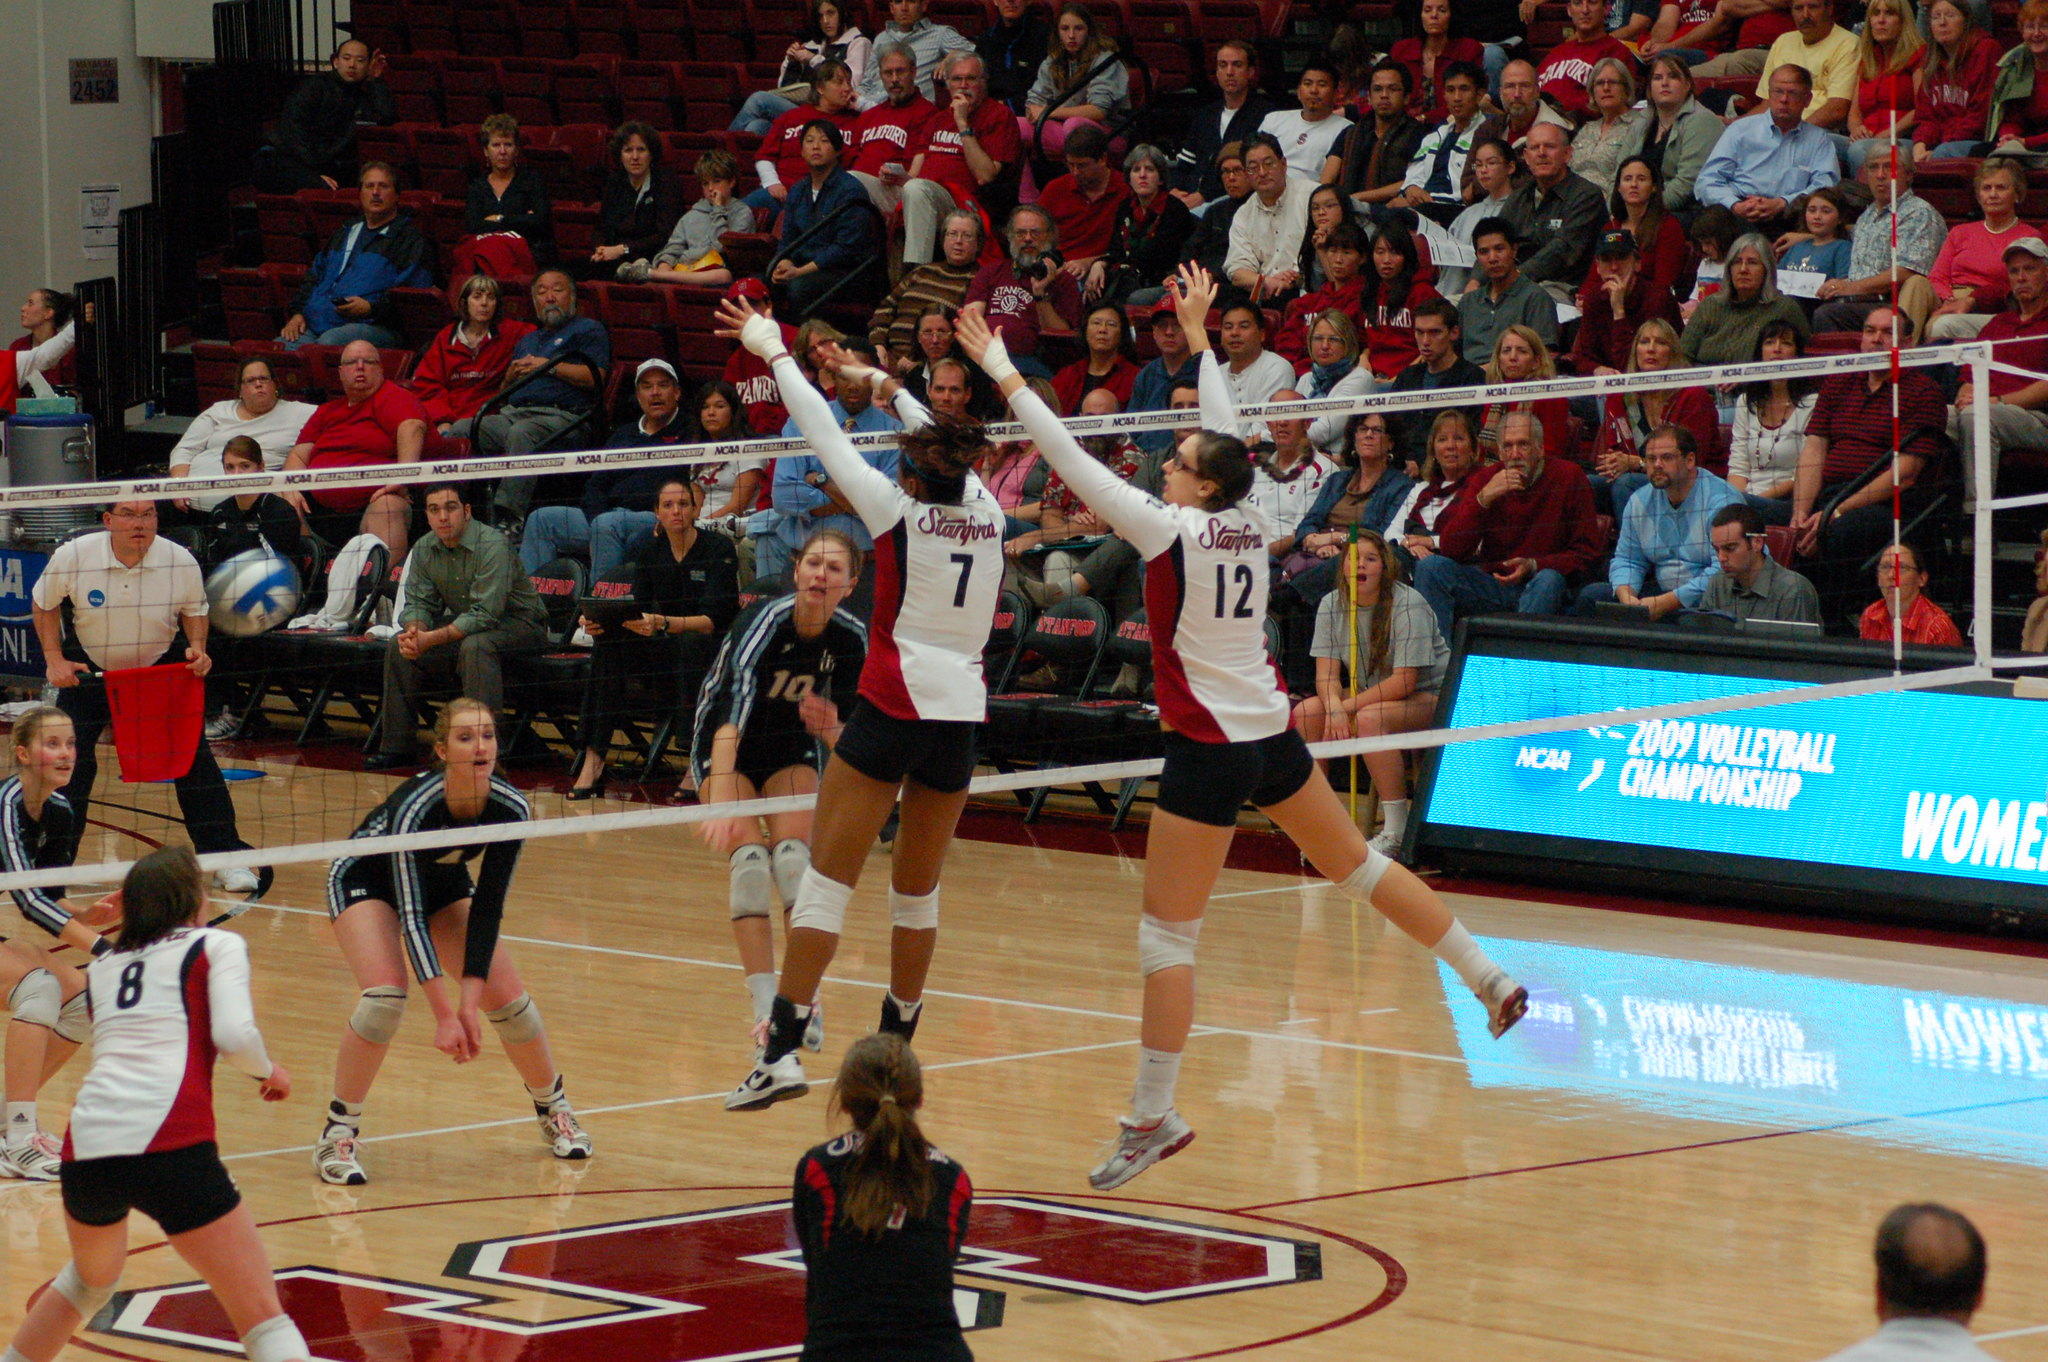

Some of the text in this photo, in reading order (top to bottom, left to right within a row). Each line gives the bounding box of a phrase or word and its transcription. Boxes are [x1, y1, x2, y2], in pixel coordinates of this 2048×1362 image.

[73, 80, 118, 102] 2452
[132, 483, 160, 494] NCAA
[284, 473, 311, 484] NCAA
[432, 464, 458, 475] NCAA
[575, 454, 600, 465] NCAA
[715, 445, 740, 455] NCAA
[1112, 417, 1136, 427] NCAA
[1239, 407, 1262, 417] NCAA
[1363, 397, 1386, 407] NCAA
[1486, 387, 1507, 397] NCAA
[1604, 378, 1626, 387] NCAA
[1721, 368, 1743, 377] NCAA
[918, 507, 997, 546] Stanford
[1199, 518, 1263, 556] Stanford
[529, 576, 575, 595] TANFORD
[950, 553, 973, 607] 7
[1215, 564, 1253, 618] 12
[1036, 616, 1097, 636] STANFORD
[1117, 621, 1152, 642] STAN
[768, 669, 816, 702] 10
[1515, 747, 1572, 771] NCAA
[1627, 719, 1836, 774] 2009 VOLLEYBALL
[1619, 758, 1802, 811] CHAMPIONSHIP
[1902, 790, 2048, 872] WOME
[117, 961, 144, 1009] 8
